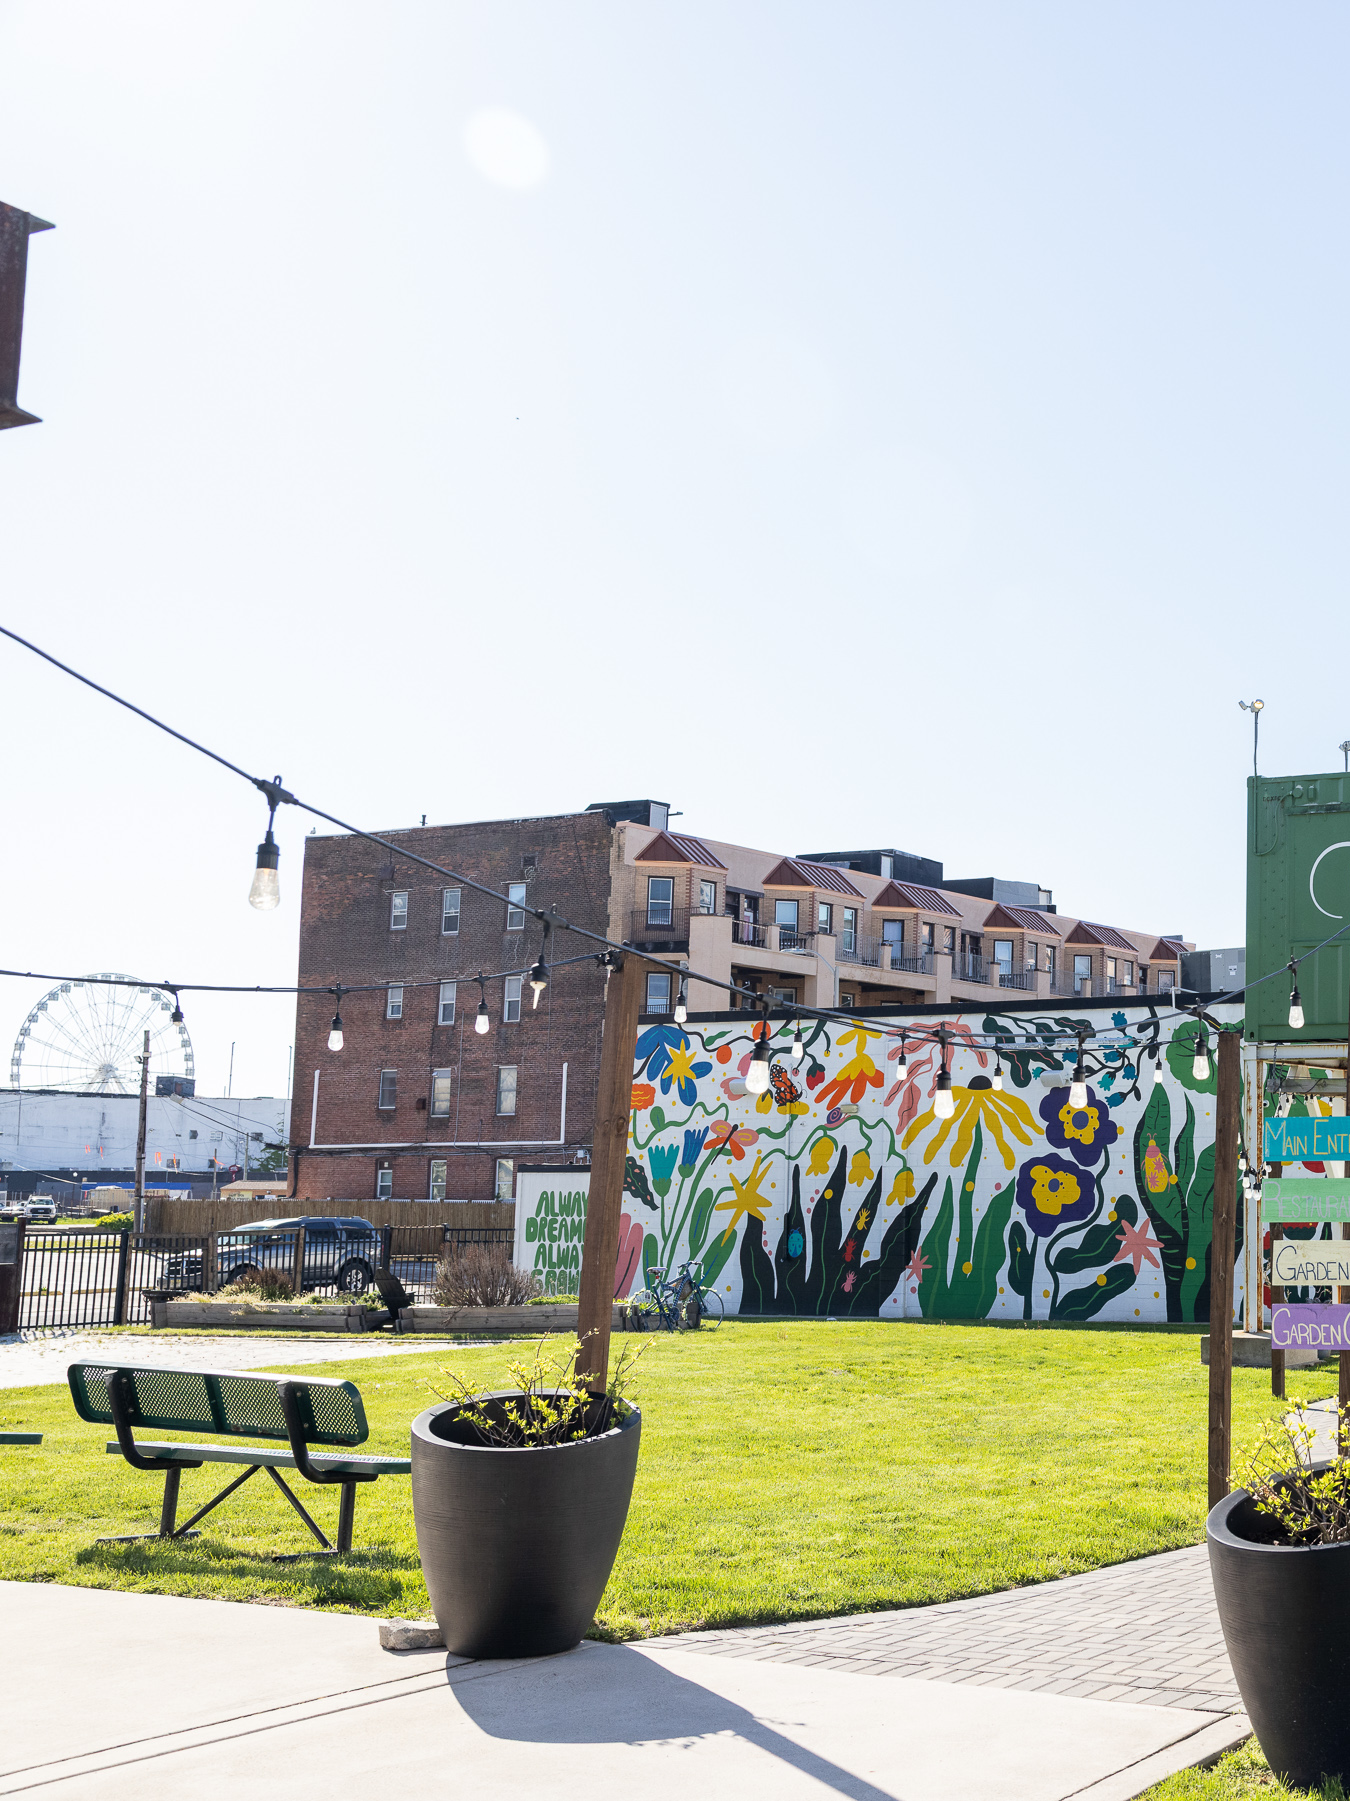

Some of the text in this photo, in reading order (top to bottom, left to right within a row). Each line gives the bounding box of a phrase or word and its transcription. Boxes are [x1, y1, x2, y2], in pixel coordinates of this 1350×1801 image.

[1264, 1121, 1308, 1158] MAIN
[535, 1190, 590, 1218] ALWAY
[1275, 1245, 1350, 1281] GARDEN
